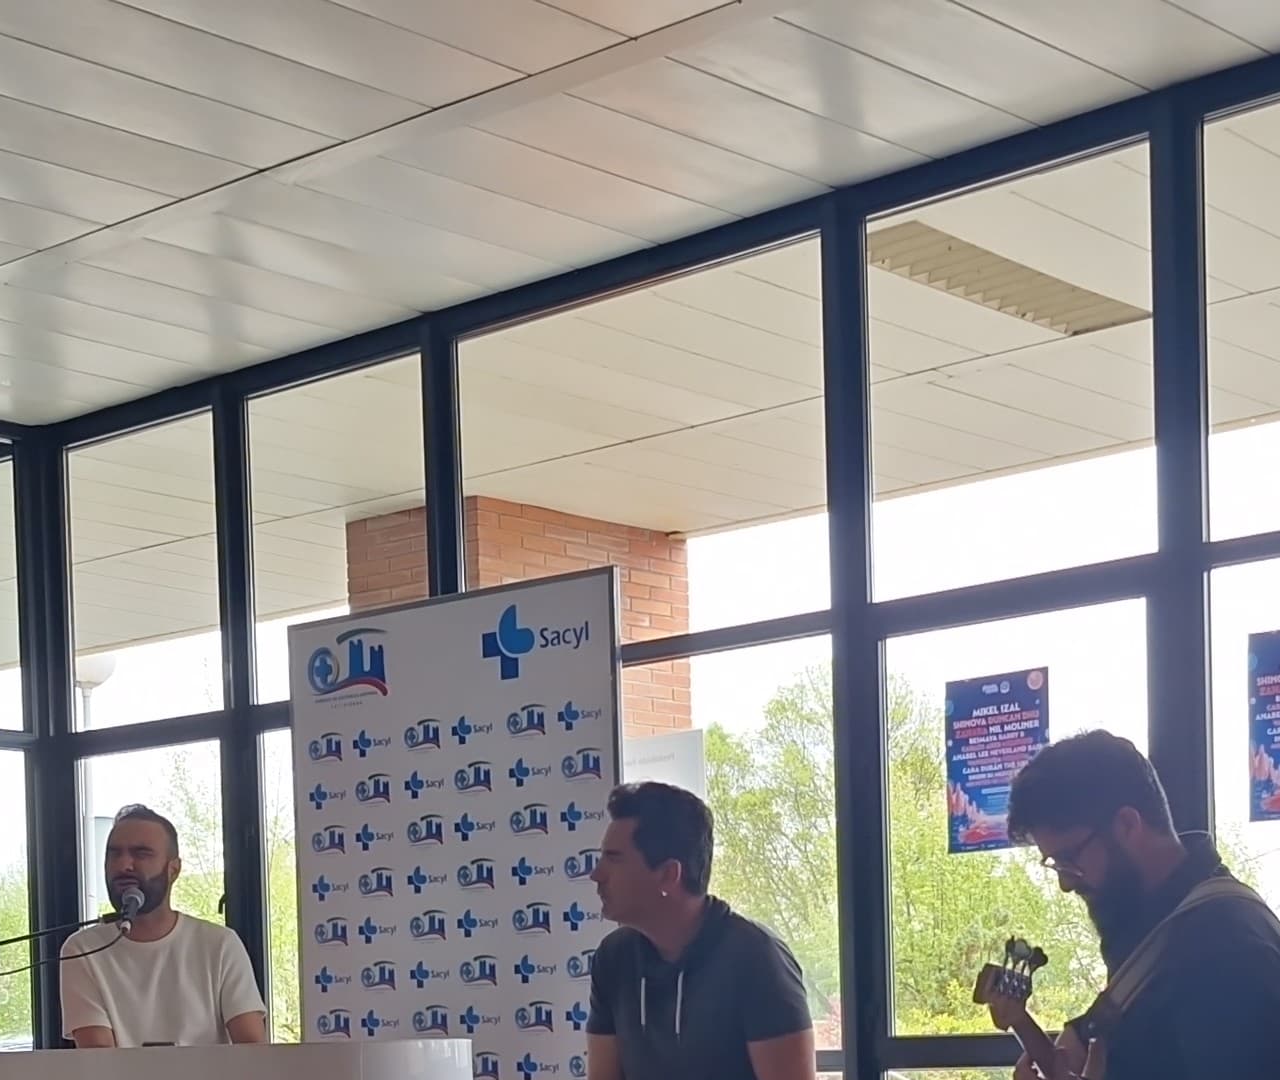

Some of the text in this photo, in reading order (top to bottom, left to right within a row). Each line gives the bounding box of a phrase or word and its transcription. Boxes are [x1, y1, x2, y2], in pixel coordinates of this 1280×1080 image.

[539, 621, 589, 649] Sacyl
[580, 708, 602, 721] Sacyl
[972, 703, 1021, 716] MIKEL IZAL
[473, 723, 493, 734] Sacyl
[989, 724, 1002, 733] NIL
[1004, 719, 1039, 732] MOLINER
[373, 736, 391, 747] Sacyl
[531, 765, 551, 778] Sacyl
[425, 779, 444, 790] Sacyl
[329, 789, 346, 800] Sacyl
[583, 809, 604, 822] Sacyl
[476, 822, 496, 833] Sacyl
[376, 831, 394, 842] Sacyl
[535, 866, 554, 877] Sacyl
[428, 873, 447, 885] Sacyl
[331, 882, 349, 893] Sacyl
[478, 919, 498, 930] Sacyl
[378, 925, 396, 937] Sacyl
[431, 969, 449, 980] Sacyl
[536, 964, 556, 976] Sacyl
[334, 974, 352, 985] Sacyl
[381, 1017, 399, 1029] Sacyl
[481, 1015, 501, 1026] Sacyl
[539, 1063, 559, 1074] Sacyl
